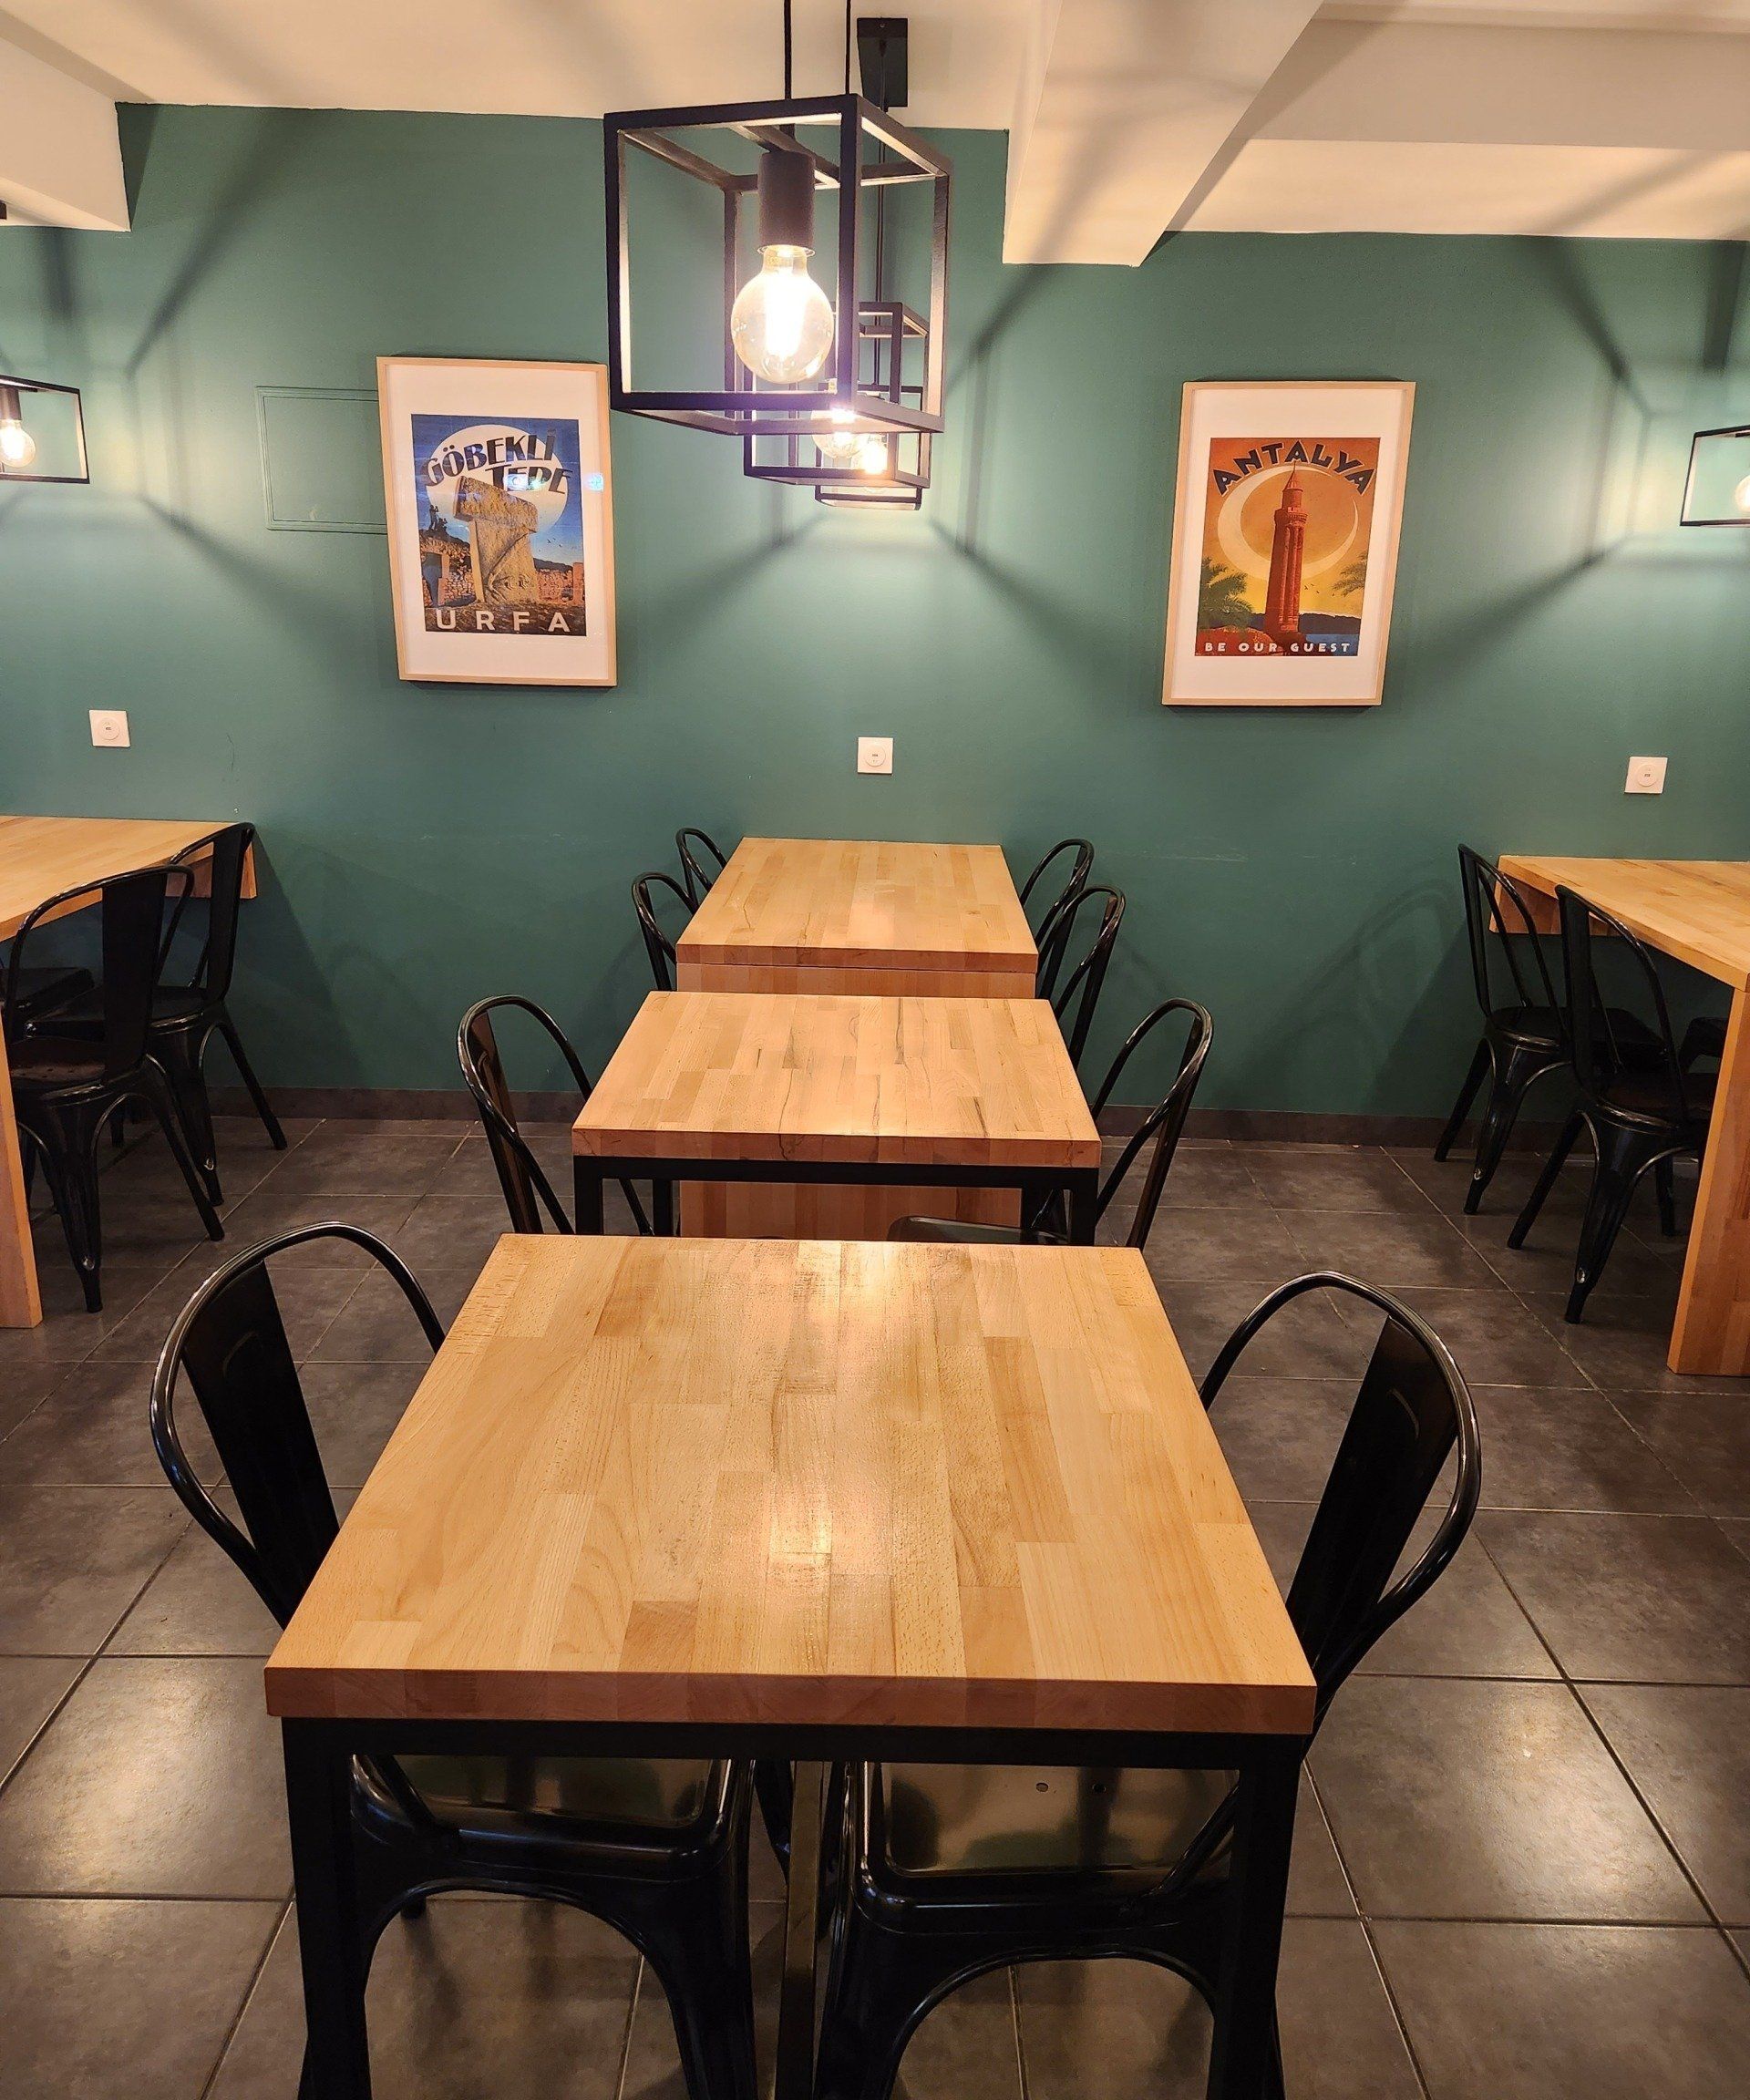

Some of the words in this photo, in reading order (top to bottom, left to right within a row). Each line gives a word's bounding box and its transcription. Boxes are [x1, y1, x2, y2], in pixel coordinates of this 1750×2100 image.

[1212, 439, 1375, 496] ANTALYA
[436, 609, 571, 633] URFA
[1204, 642, 1227, 652] BE
[1238, 642, 1278, 652] OUR
[1290, 643, 1351, 653] GUEST
